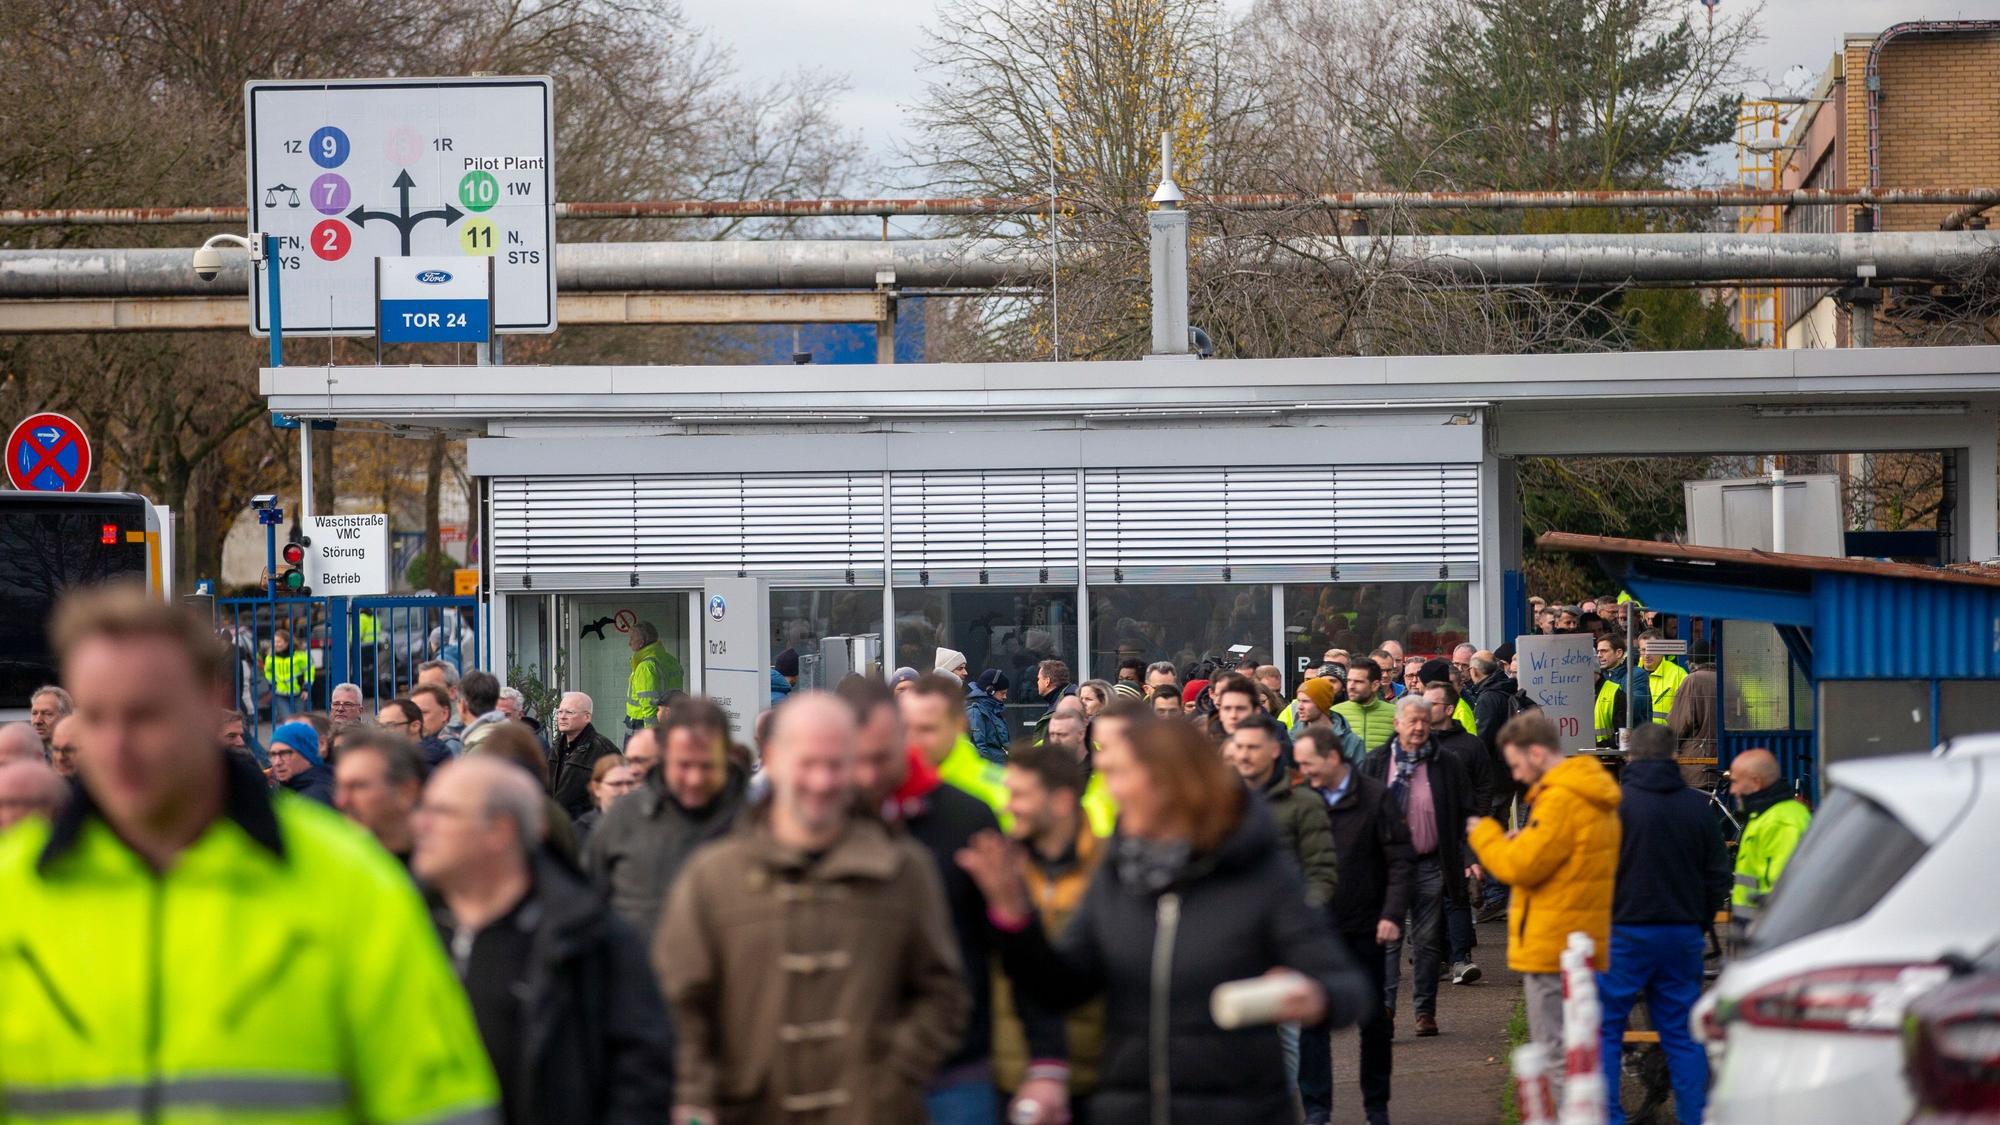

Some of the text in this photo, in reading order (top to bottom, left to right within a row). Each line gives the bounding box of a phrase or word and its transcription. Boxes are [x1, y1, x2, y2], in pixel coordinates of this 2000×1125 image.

[284, 136, 337, 158] 1Z 9
[433, 138, 453, 151] 1R
[464, 156, 544, 170] Pilot Plant
[322, 183, 338, 205] 7
[464, 181, 531, 202] 10 1W
[322, 229, 338, 251] 2
[467, 227, 524, 248] 11 N,
[508, 251, 540, 264] STS
[403, 313, 467, 327] TOR 24
[315, 514, 384, 527] Waschstraße
[336, 527, 361, 539] VMC
[322, 546, 365, 560] Störung
[322, 572, 361, 585] Betrieb
[709, 640, 727, 655] Tor 24
[1530, 648, 1592, 672] Wir stehen
[1532, 676, 1544, 686] an
[1538, 689, 1569, 706] Seite
[1553, 717, 1579, 737] PD
